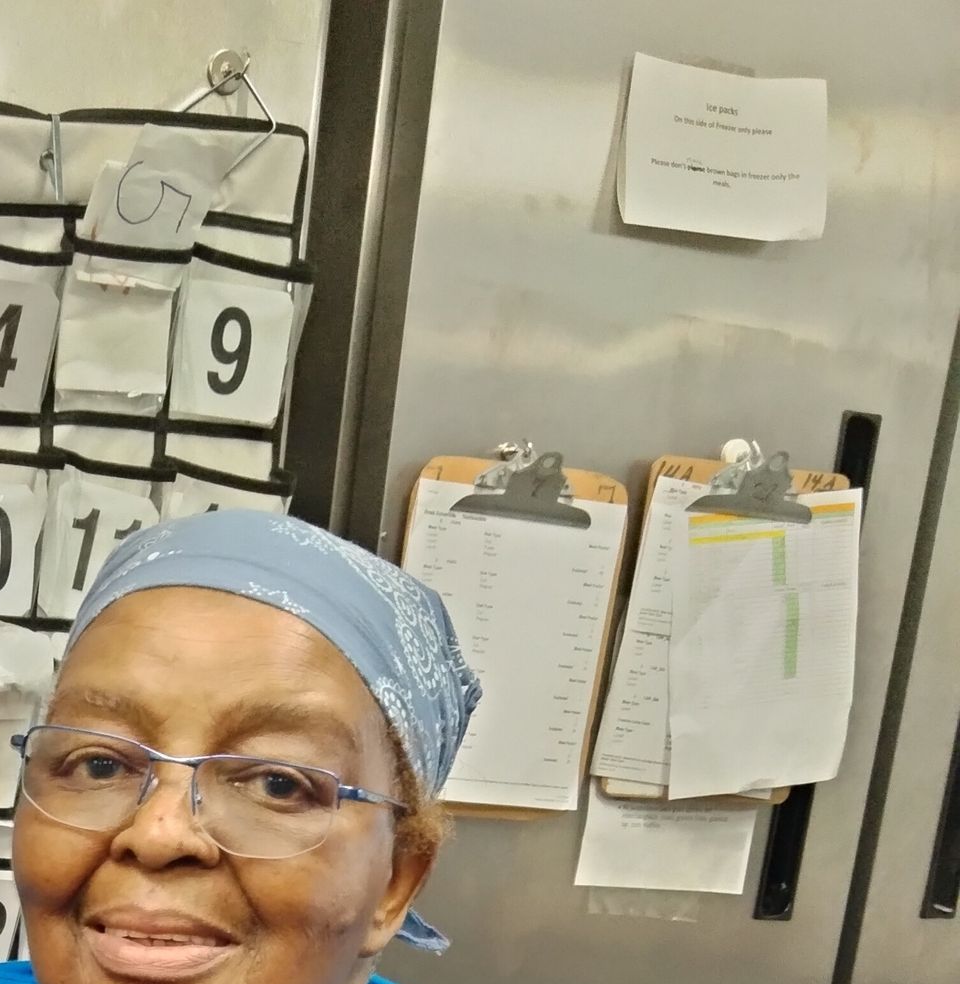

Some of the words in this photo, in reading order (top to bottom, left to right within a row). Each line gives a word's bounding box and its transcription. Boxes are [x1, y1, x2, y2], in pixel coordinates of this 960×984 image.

[719, 105, 739, 117] packs
[696, 119, 707, 128] side
[752, 127, 772, 136] please
[71, 507, 143, 592] 1
